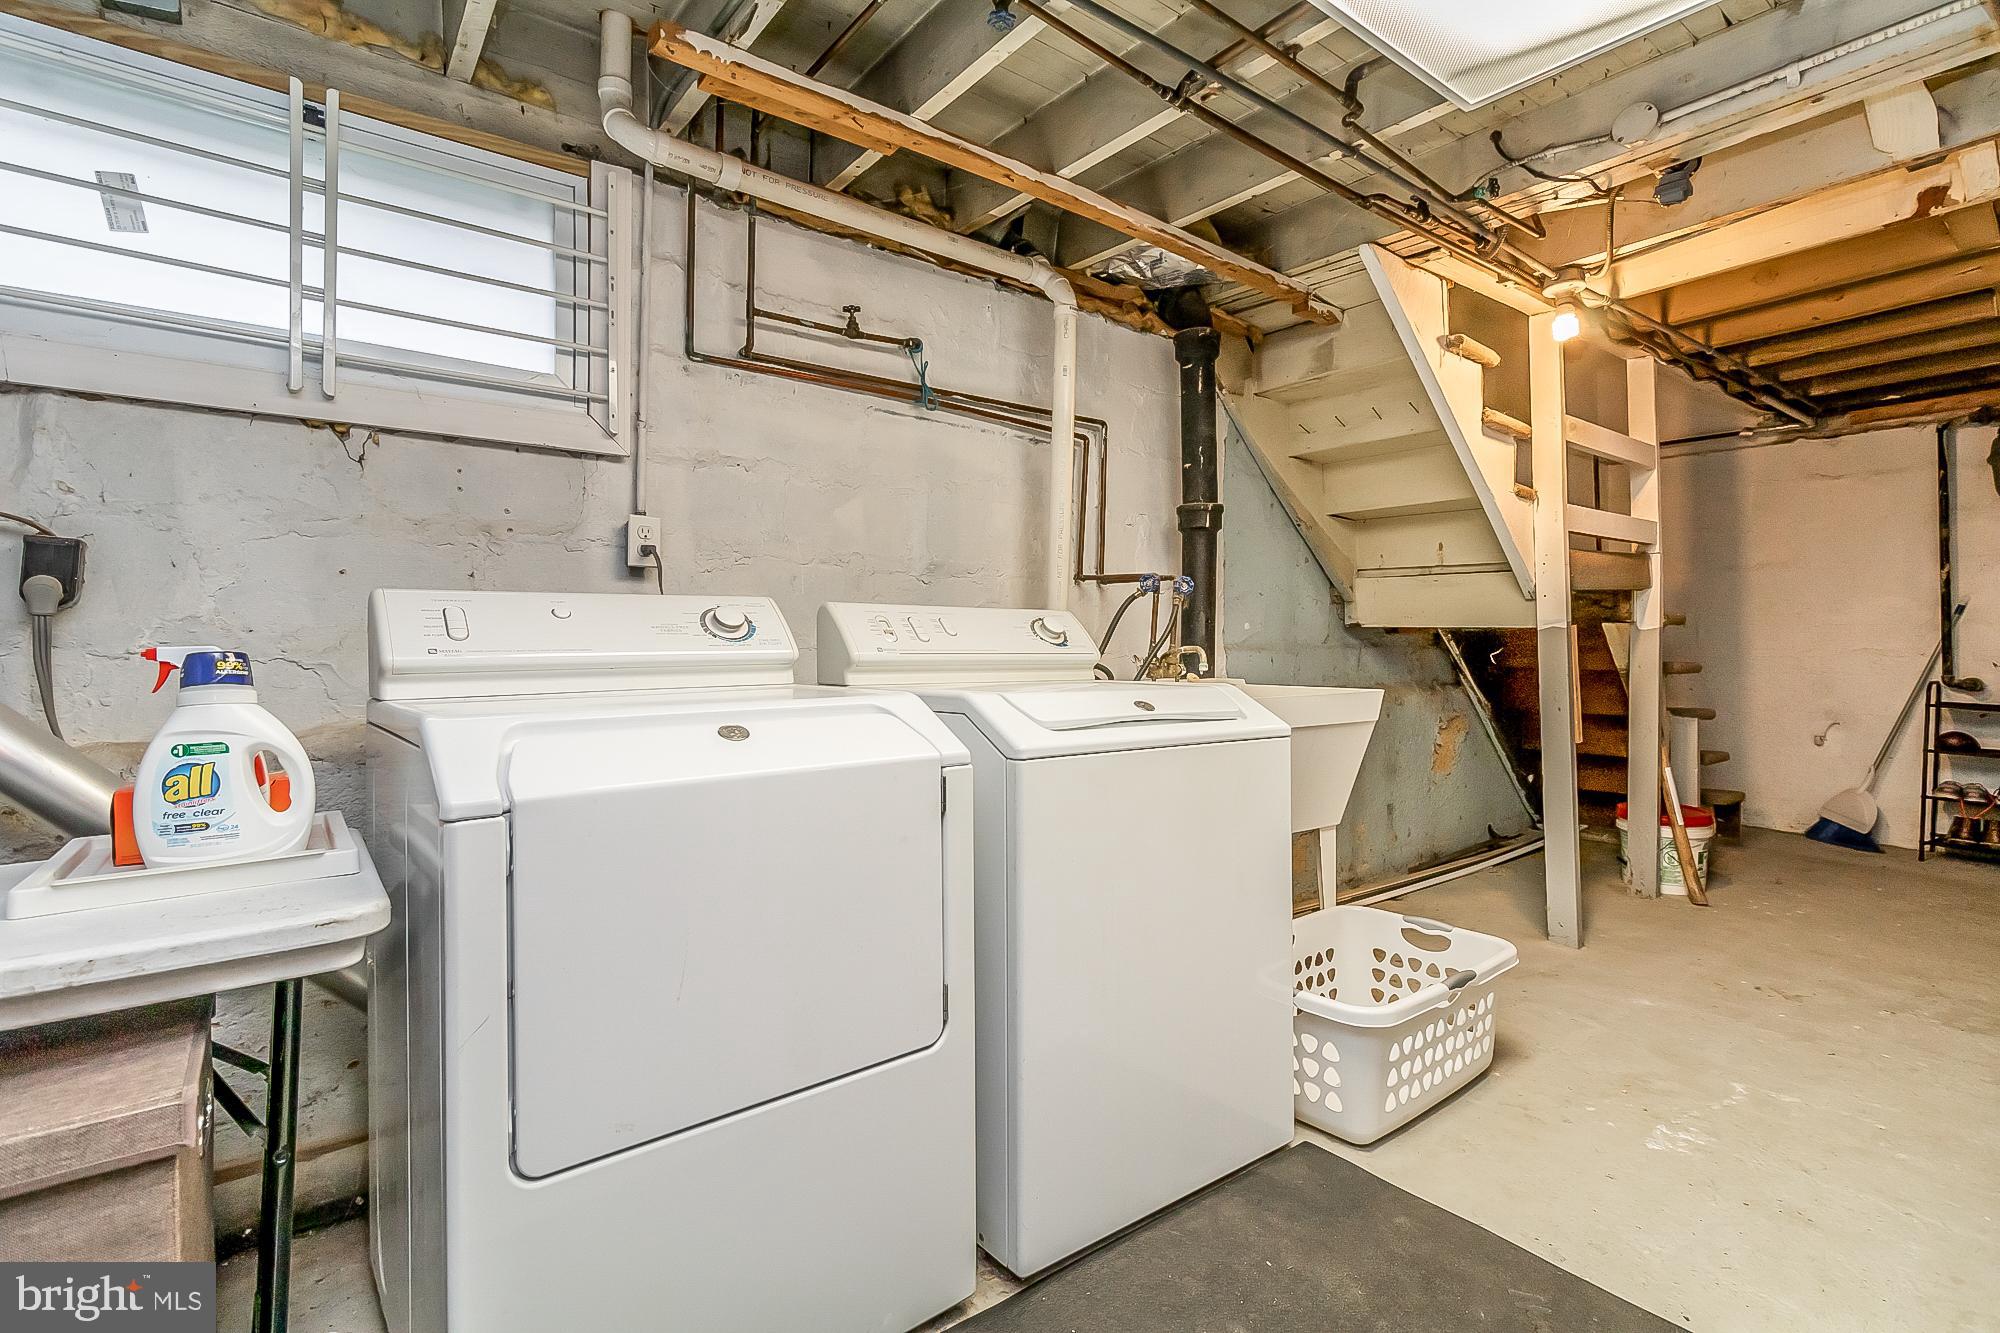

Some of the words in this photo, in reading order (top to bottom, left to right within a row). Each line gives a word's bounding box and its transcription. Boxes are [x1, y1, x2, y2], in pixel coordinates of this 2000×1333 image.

[762, 174, 780, 186] FOR
[785, 182, 829, 202] PRESSURE
[216, 660, 243, 671] 99%
[164, 762, 216, 803] all
[162, 811, 187, 820] free
[192, 808, 226, 818] clear
